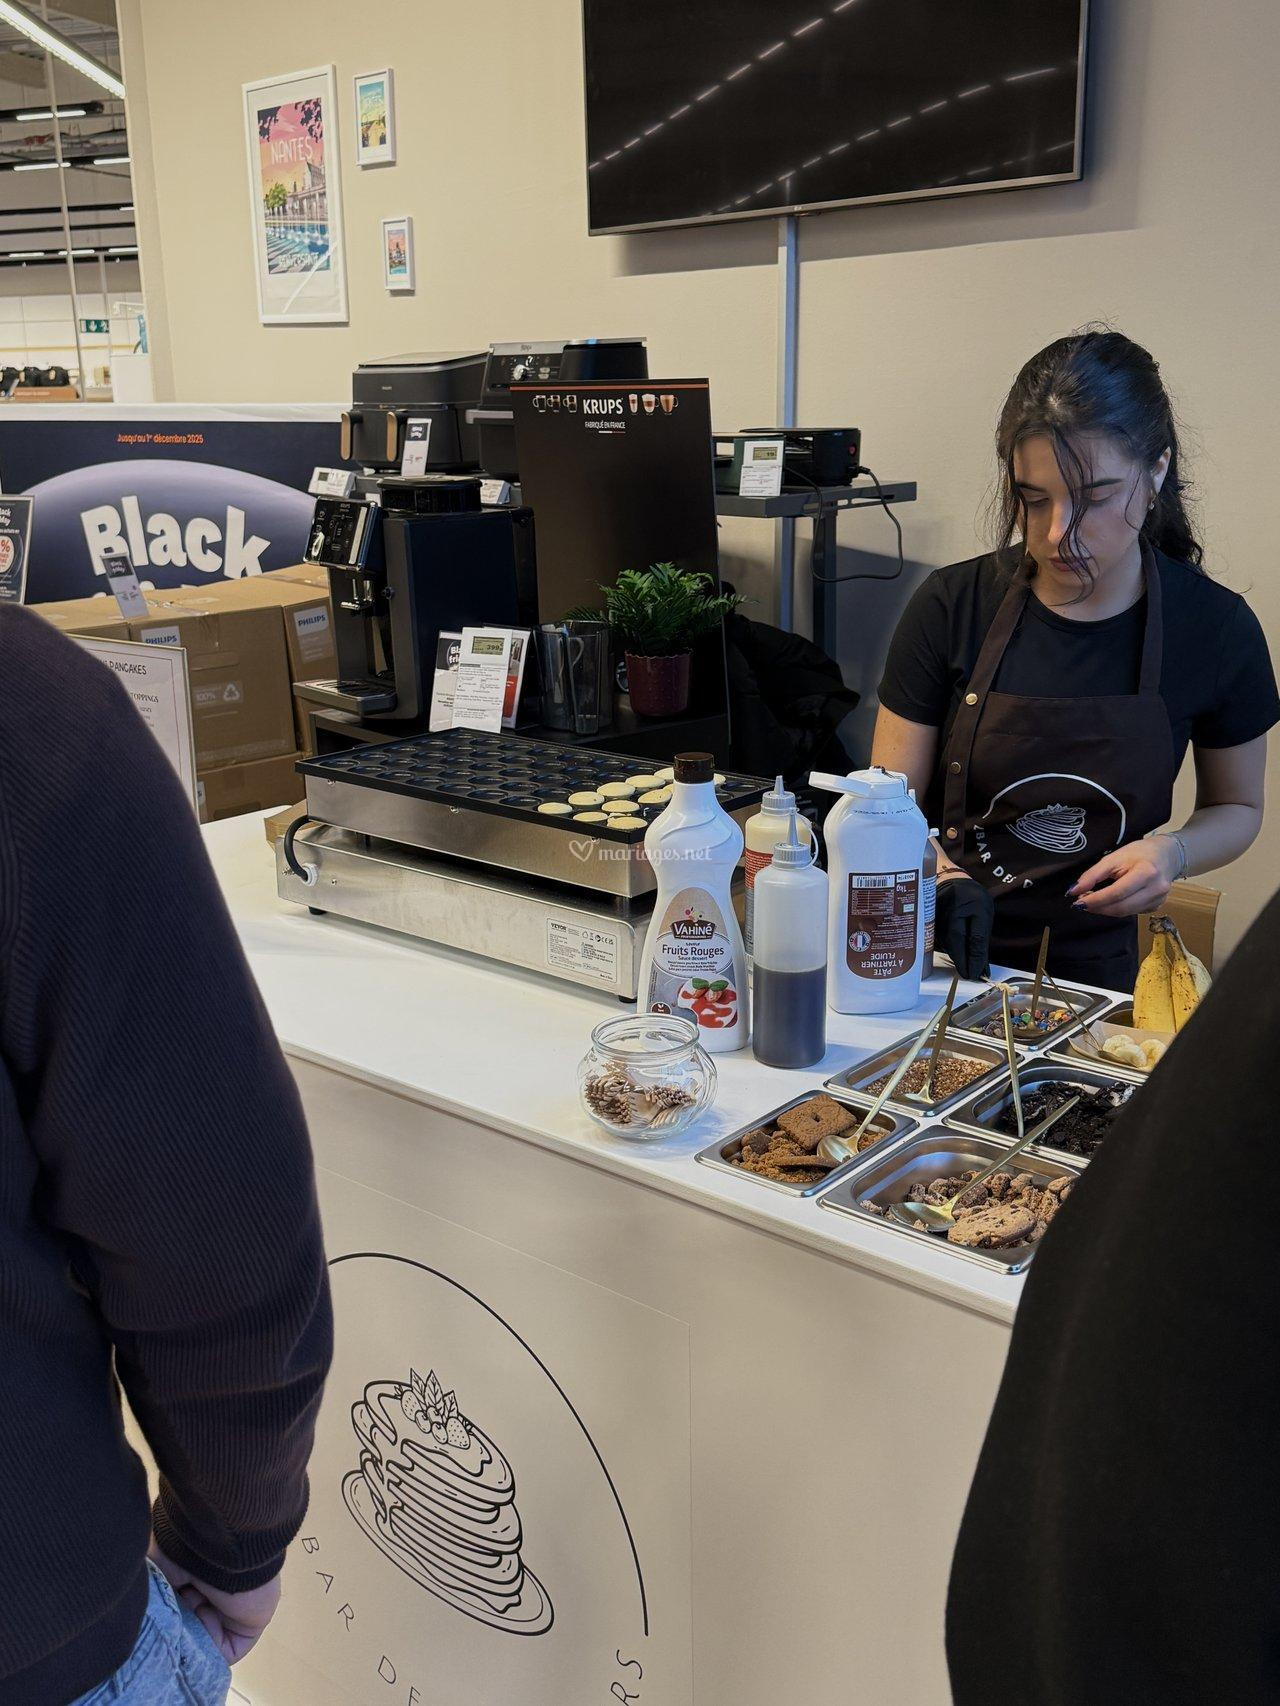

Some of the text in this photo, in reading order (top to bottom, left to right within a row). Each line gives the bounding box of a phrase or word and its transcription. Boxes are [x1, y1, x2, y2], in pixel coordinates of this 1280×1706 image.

[270, 136, 314, 165] NANTES
[583, 398, 624, 415] KRUPS
[610, 421, 625, 429] FRANCE
[153, 433, 187, 443] décembre
[187, 433, 204, 443] 2025
[80, 495, 271, 580] Black
[297, 614, 326, 627] PHILIPS
[145, 635, 178, 645] PHILIPS
[109, 660, 147, 675] PANCAKES
[993, 865, 1017, 884] DES
[662, 944, 725, 958] Fruits Rouges
[870, 952, 896, 961] FLUIDE
[861, 960, 898, 968] TARTINER
[873, 968, 892, 977] PÂTE
[301, 1537, 355, 1632] BAR
